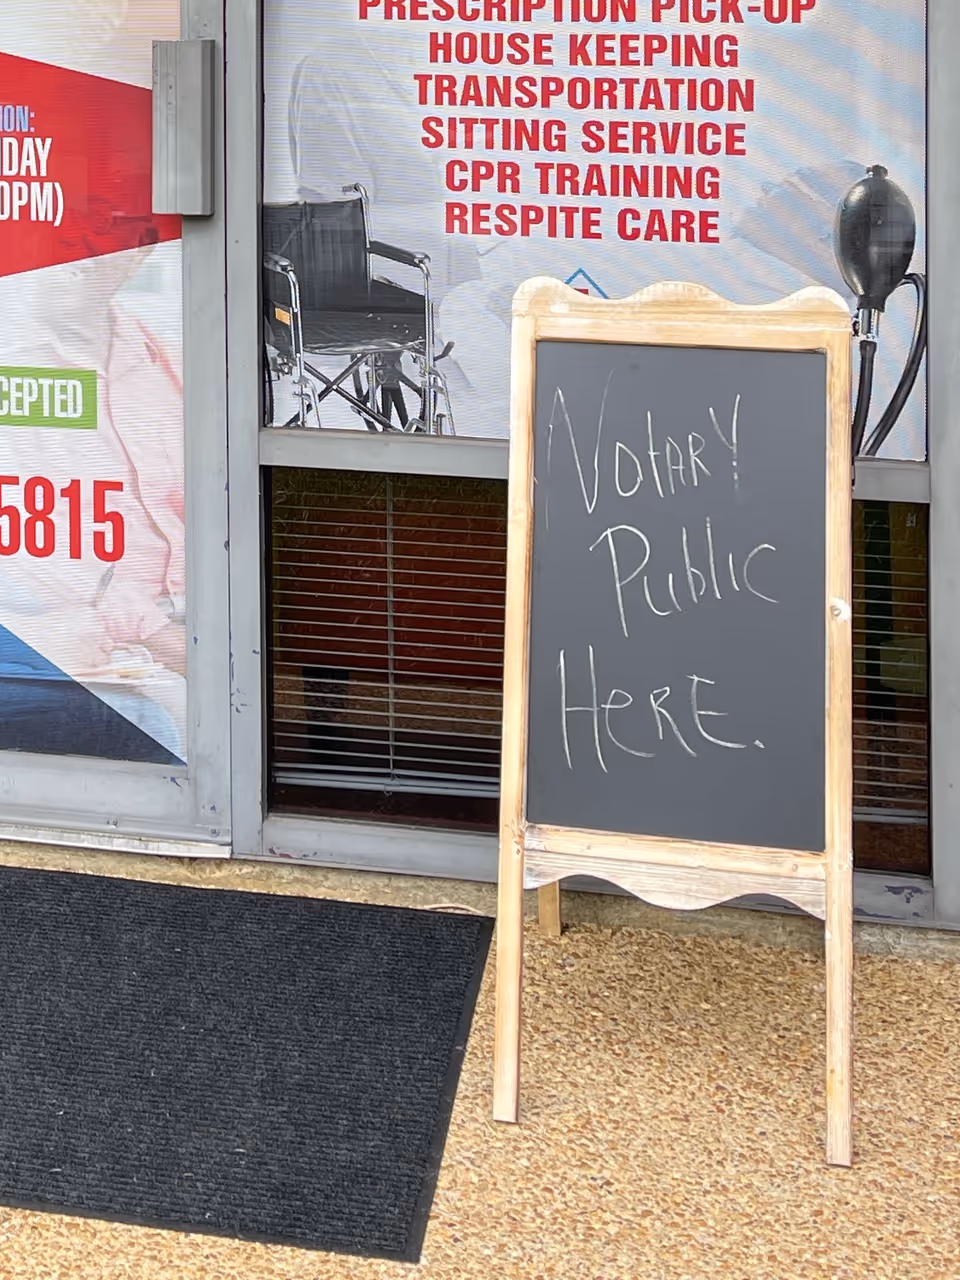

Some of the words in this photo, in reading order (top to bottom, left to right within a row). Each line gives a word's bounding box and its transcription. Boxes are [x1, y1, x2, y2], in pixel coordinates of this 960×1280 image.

[428, 31, 554, 66] HOUSE
[568, 33, 739, 68] KEEPING
[412, 74, 755, 112] TRANSPORTATION
[421, 116, 567, 153] SITTING
[581, 119, 747, 157] SERVICE
[445, 159, 521, 194] CPR
[533, 161, 721, 200] TRAINING
[445, 202, 603, 240] RESPITE
[616, 207, 721, 244] CARE
